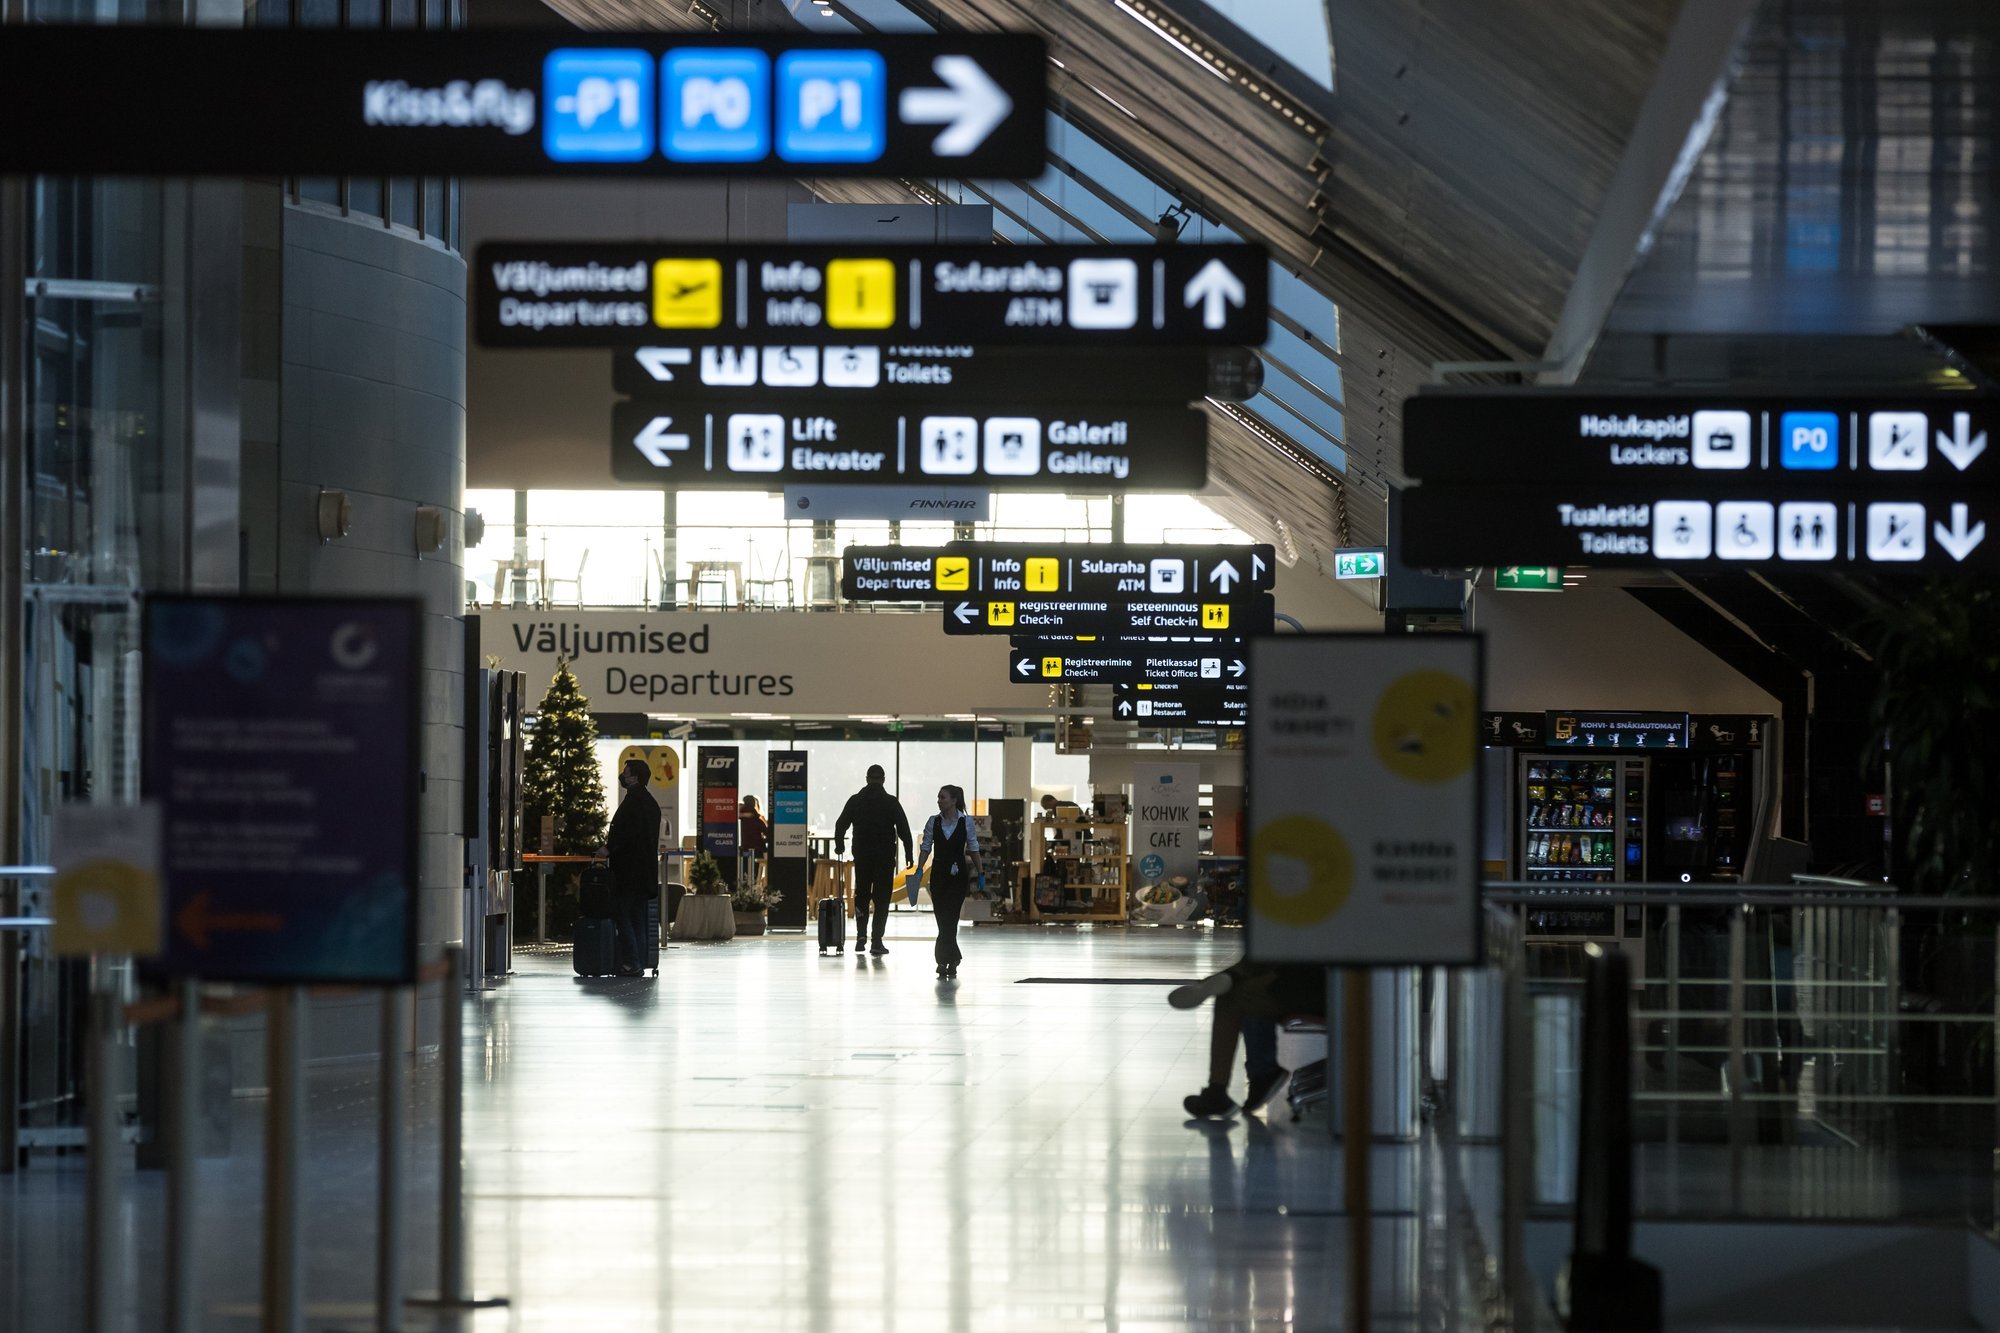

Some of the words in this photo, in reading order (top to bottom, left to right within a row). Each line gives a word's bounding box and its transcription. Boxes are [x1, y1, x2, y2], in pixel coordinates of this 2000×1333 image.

[364, 80, 535, 135] Kiss&fly
[799, 76, 865, 130] P1
[761, 261, 822, 292] Info
[934, 261, 1063, 292] Sularaha
[499, 298, 648, 330] Departures
[766, 296, 822, 327] Info
[1005, 297, 1063, 326] ATM
[885, 362, 953, 384] Toilets
[792, 416, 837, 442] Lift
[1047, 420, 1128, 445] Galerii
[1792, 427, 1828, 452] P0
[792, 447, 885, 471] Elevator
[1610, 444, 1689, 465] Lockers
[1047, 451, 1130, 480] Gallery
[909, 499, 977, 509] FINNAIR
[1558, 504, 1649, 527] Tualetid
[1580, 532, 1649, 554] Toilets
[853, 557, 932, 574] Väljumised
[991, 558, 1021, 573] Info
[1081, 559, 1146, 574] Sularaha
[856, 576, 932, 592] Departures
[994, 576, 1021, 591] Info
[1117, 578, 1146, 592] ATM
[1019, 614, 1063, 625] Check-in
[1130, 615, 1152, 626] Self
[1154, 616, 1199, 627] Check-in
[512, 622, 710, 661] Väljumised
[1064, 658, 1133, 668] Registreerimine
[1144, 658, 1198, 667] Piletikassad
[1064, 669, 1099, 677] Check-in
[1144, 669, 1169, 678] Ticket
[1171, 669, 1198, 678] Offices
[606, 667, 794, 702] Departures
[1153, 701, 1183, 709] Restoran
[1153, 709, 1187, 717] Restaurant
[1609, 722, 1616, 730] &
[706, 757, 735, 769] LOT
[776, 762, 804, 773] LOT
[1141, 805, 1190, 822] KOHVIK
